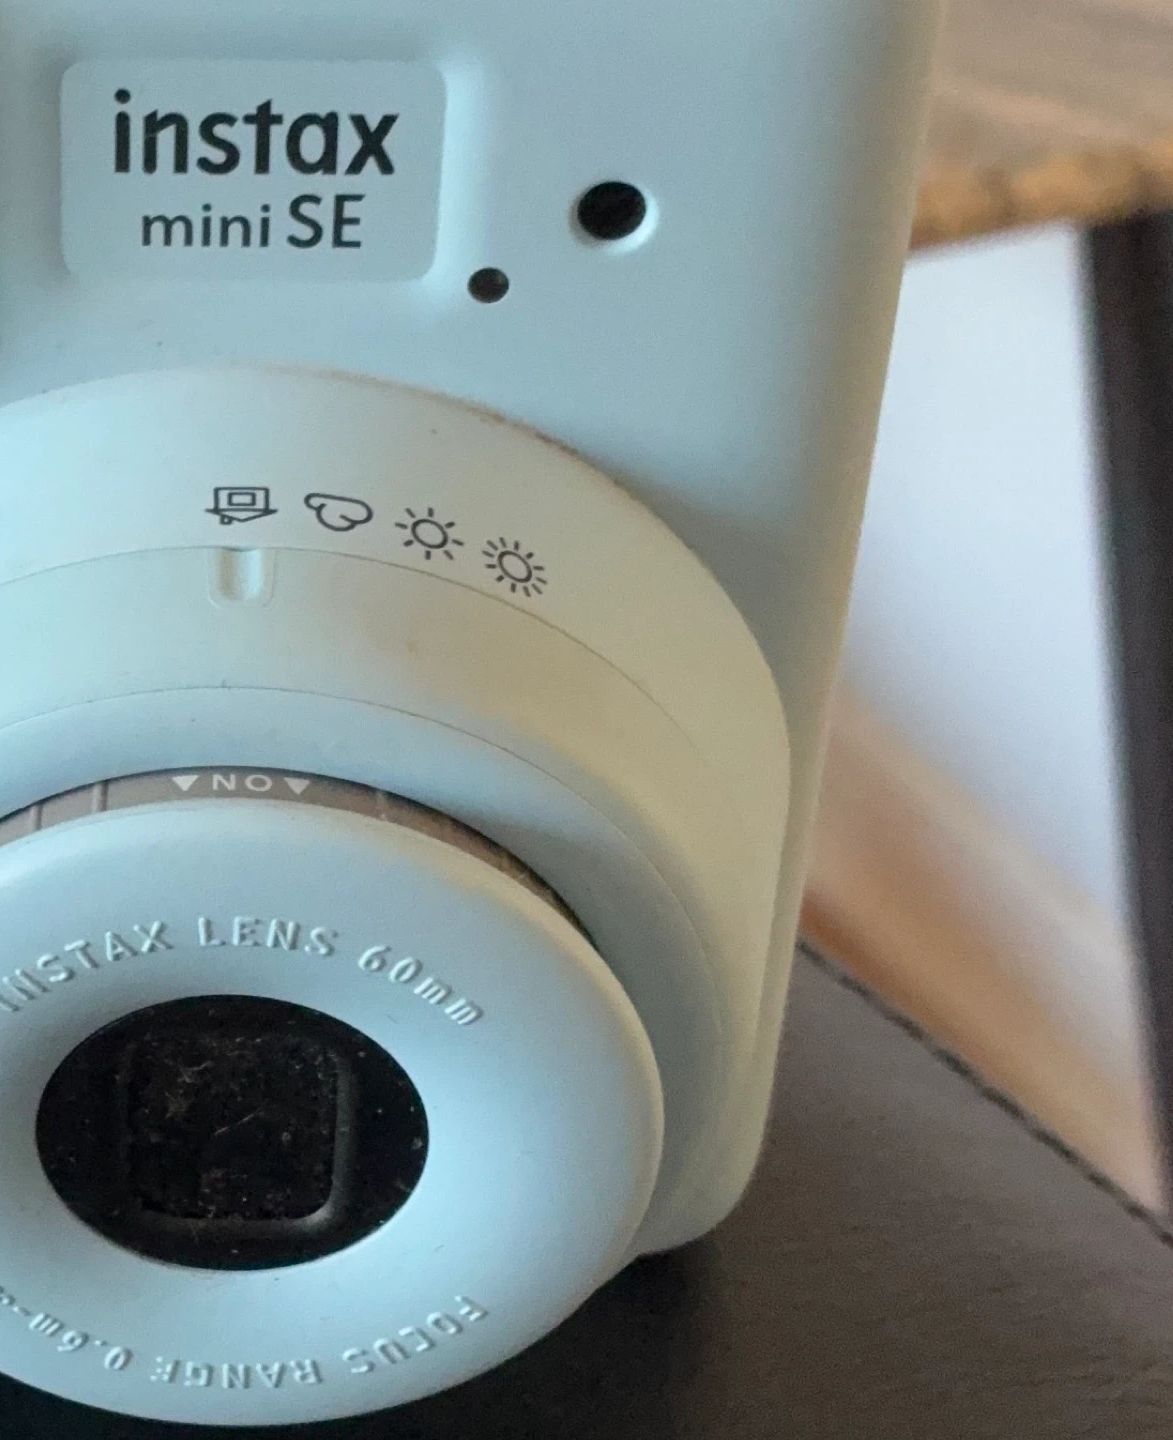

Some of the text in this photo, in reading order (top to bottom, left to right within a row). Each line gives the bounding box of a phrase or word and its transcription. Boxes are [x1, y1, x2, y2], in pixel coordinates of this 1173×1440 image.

[113, 88, 400, 176] instax
[141, 193, 366, 249] mini SE
[197, 916, 337, 958] LENS
[357, 944, 486, 1027] 60mm
[150, 1356, 323, 1389] RANGE
[341, 1295, 489, 1375] FOCUS
